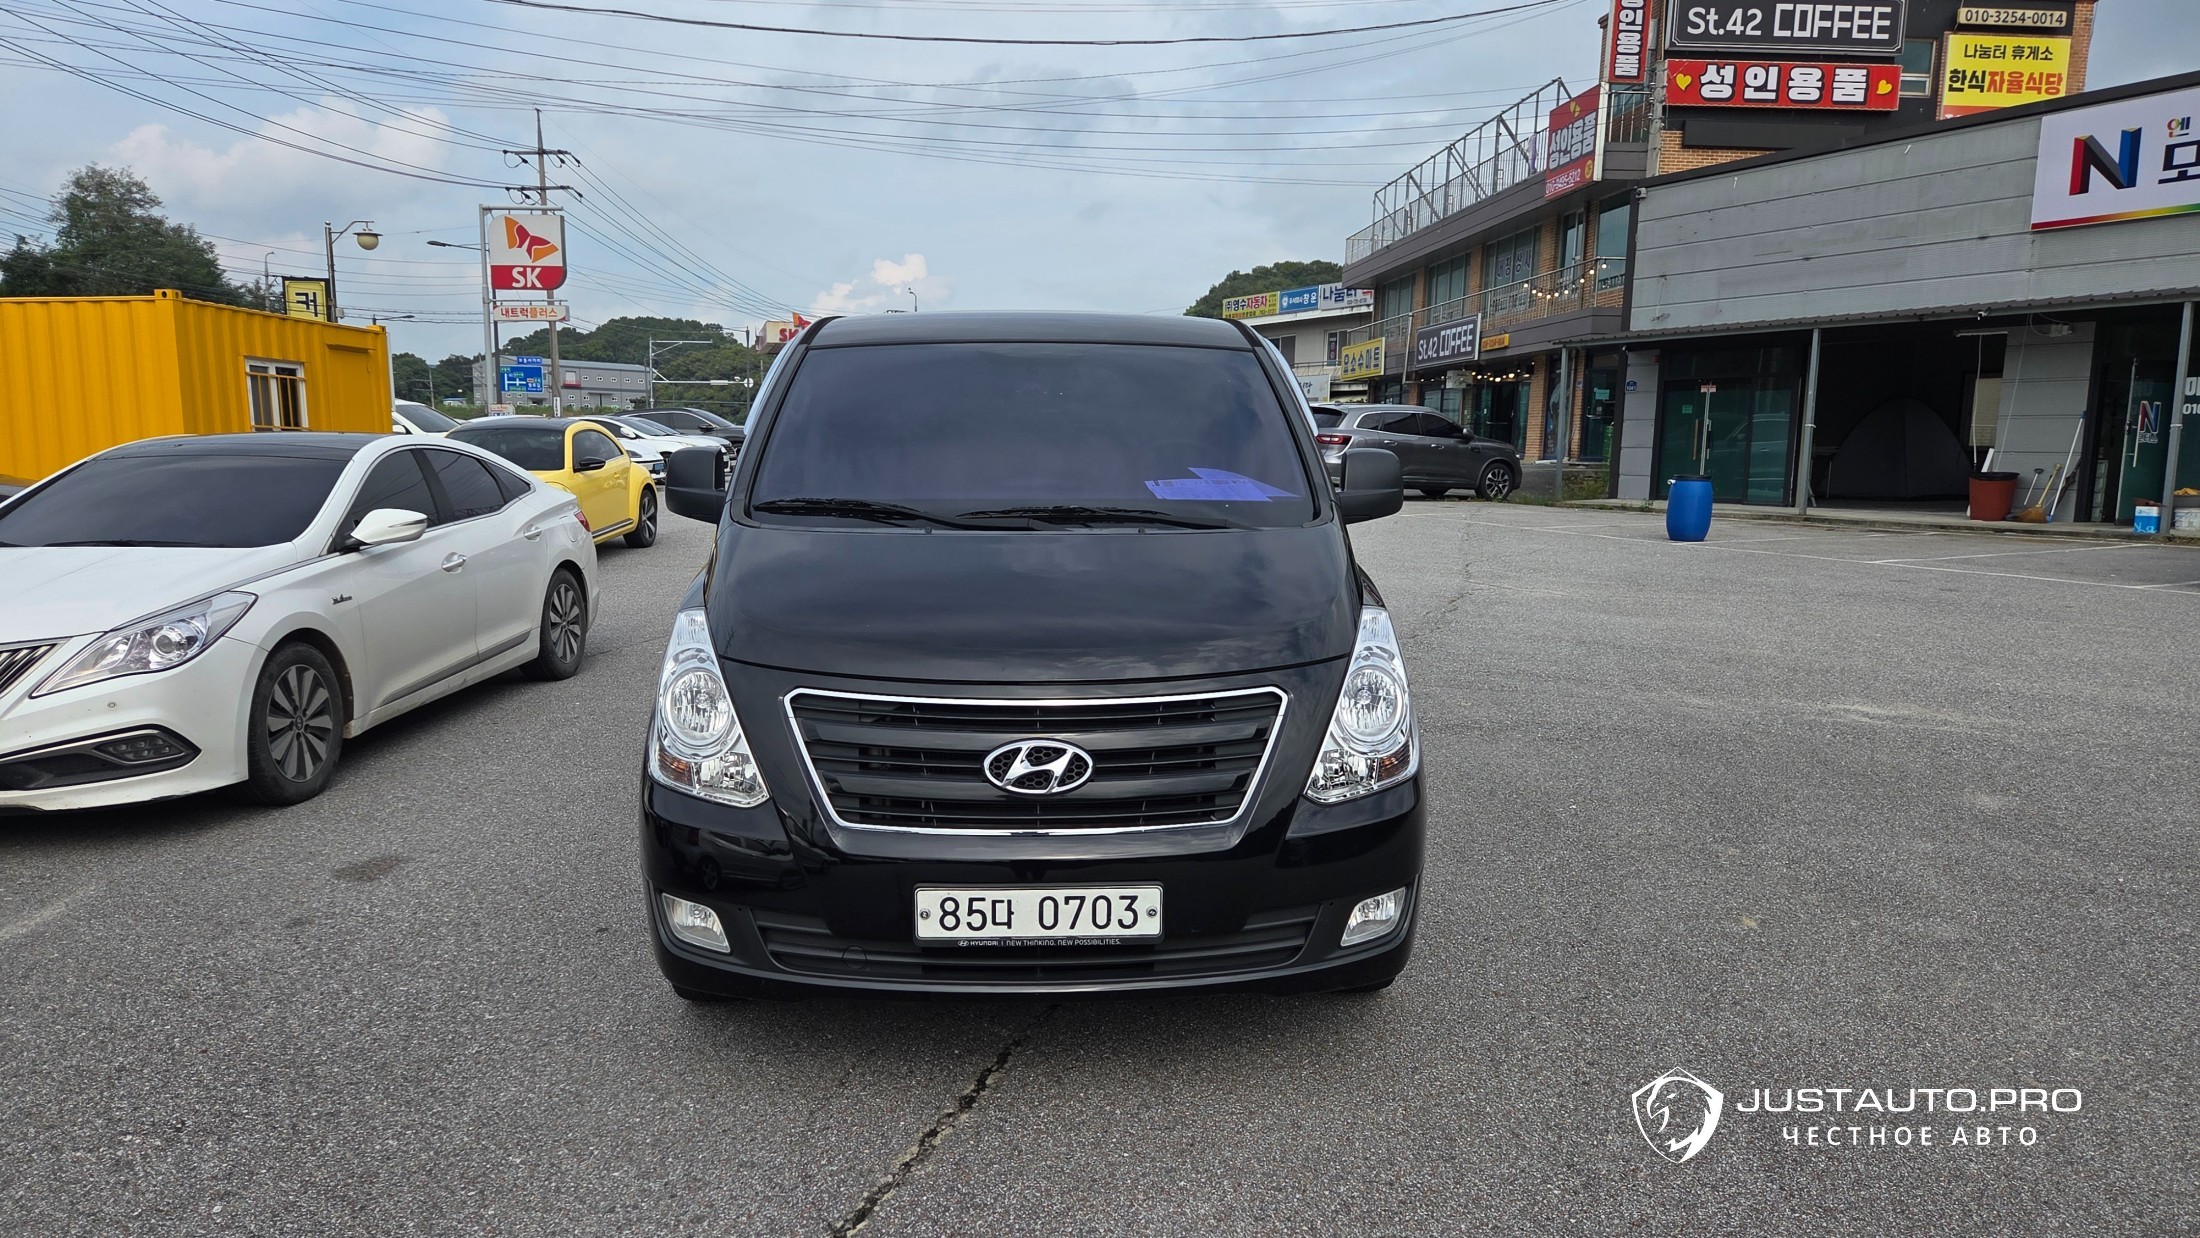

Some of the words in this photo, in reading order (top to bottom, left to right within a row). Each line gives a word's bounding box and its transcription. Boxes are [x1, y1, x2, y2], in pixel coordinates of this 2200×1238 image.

[1687, 7, 1762, 35] St.42
[1773, 4, 1892, 40] COFFEE
[1965, 10, 2064, 25] 010-3254-0014
[1964, 43, 2007, 60] 나눔터
[2011, 45, 2054, 61] 휴게소
[1549, 111, 1597, 169] 성인용품
[2069, 127, 2142, 196] N
[512, 266, 543, 288] SK
[501, 307, 558, 318] 내트럭플러스
[1418, 337, 1437, 360] St.42
[1439, 323, 1474, 357] COFFEE
[1343, 346, 1380, 375] 요소수마트
[2139, 401, 2162, 433] N
[938, 896, 1015, 932] 85다
[1037, 895, 1139, 931] 0703
